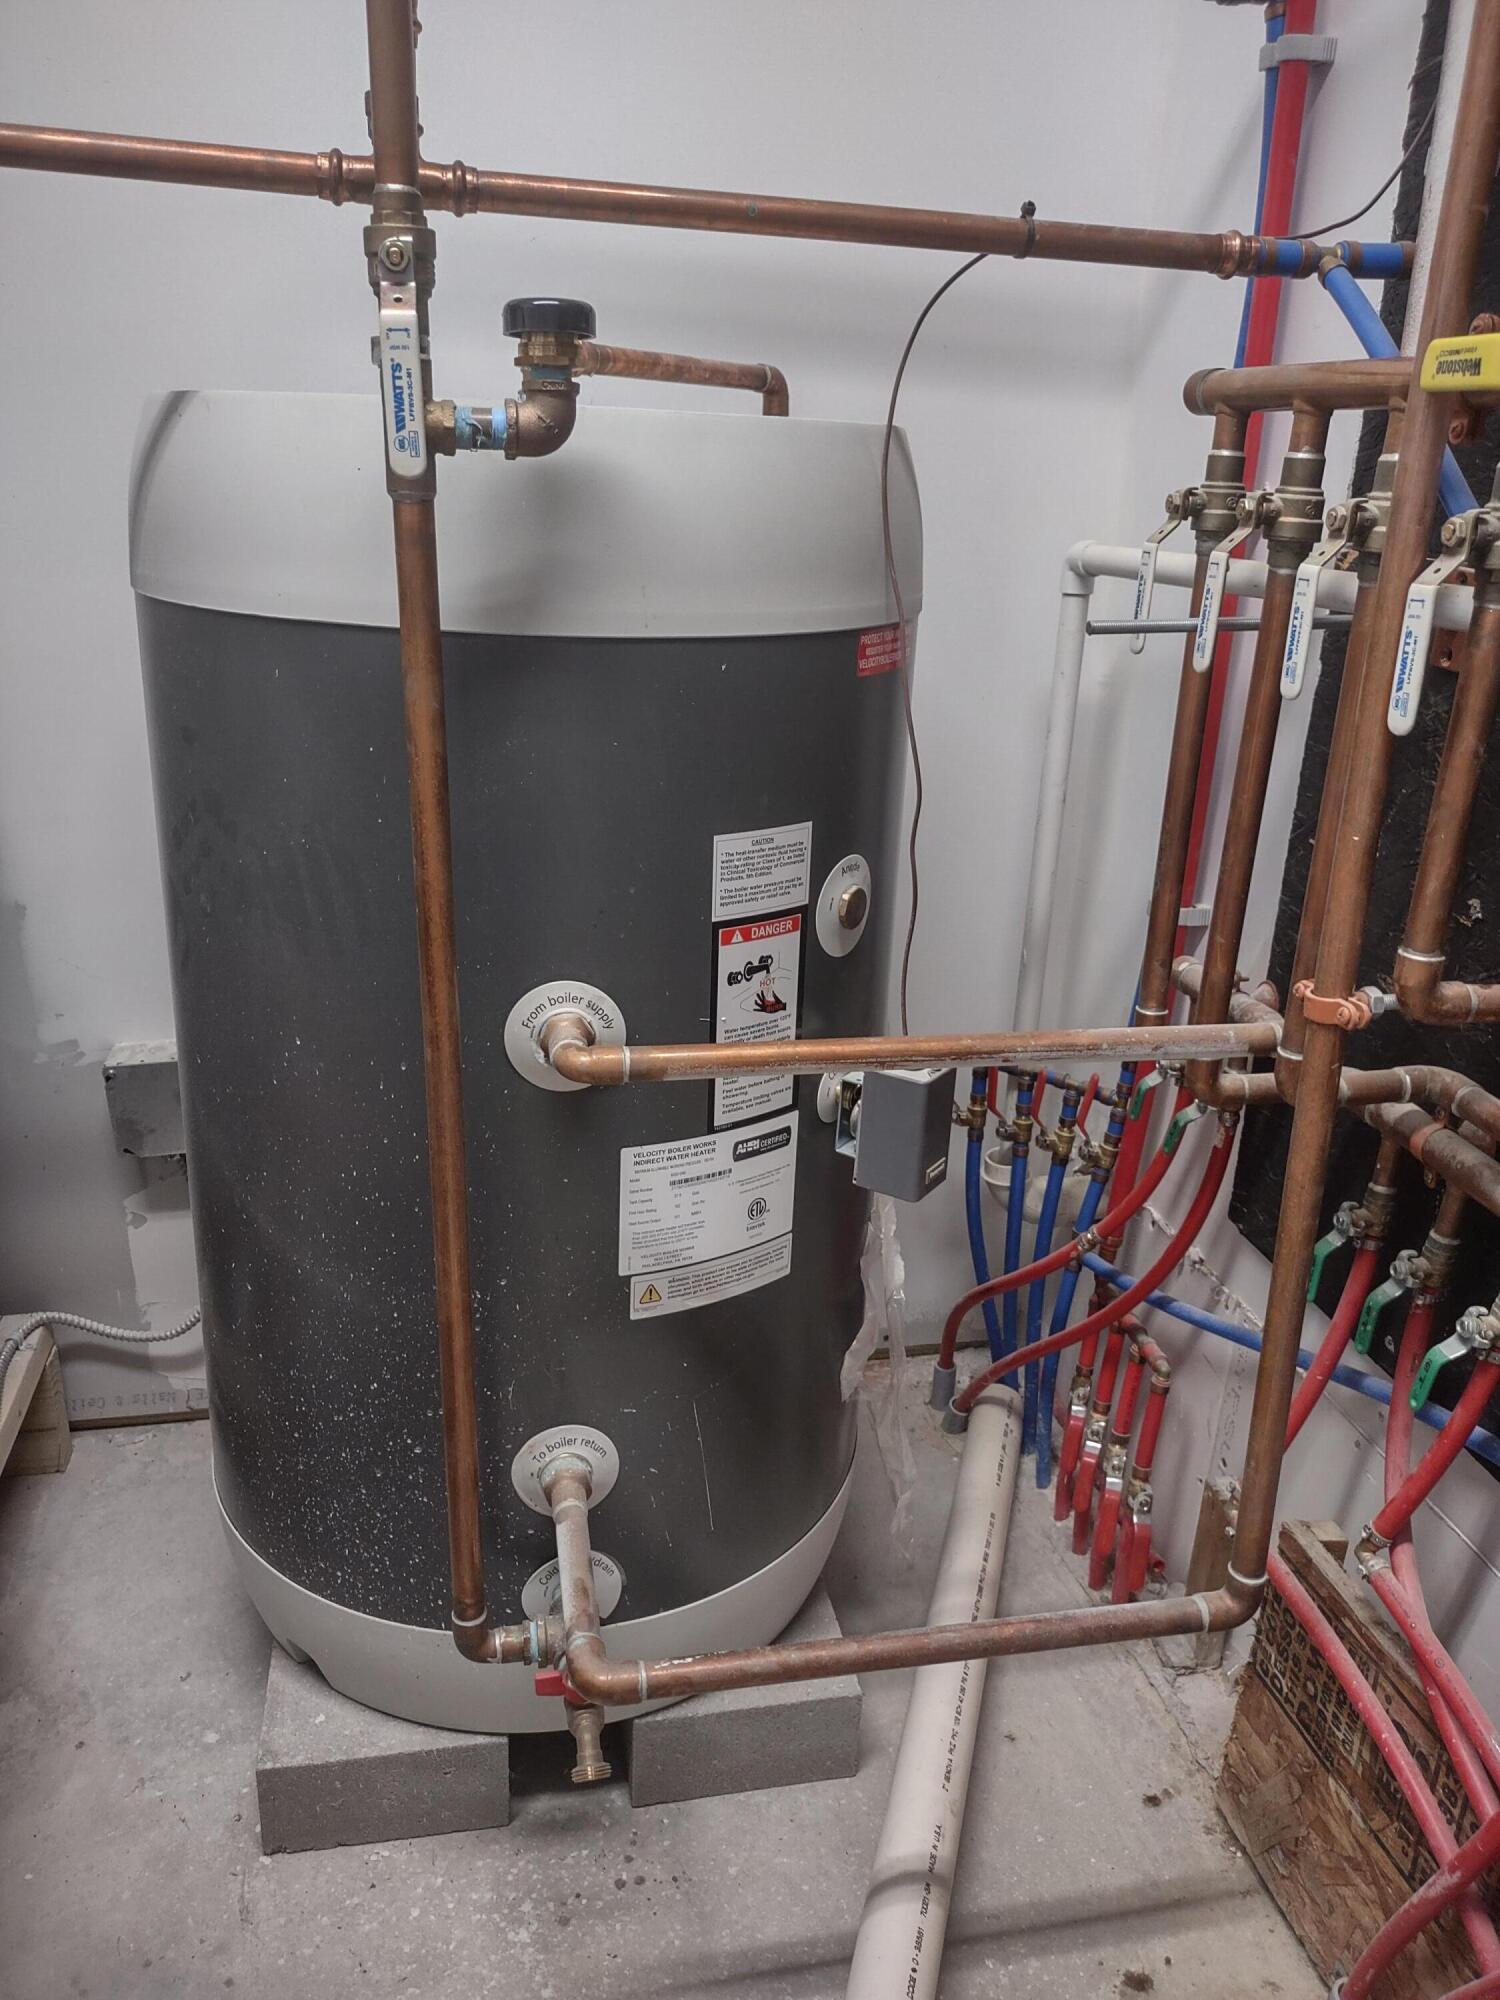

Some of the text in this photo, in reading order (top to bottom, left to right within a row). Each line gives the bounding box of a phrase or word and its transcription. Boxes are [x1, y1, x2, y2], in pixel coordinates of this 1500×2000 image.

[1436, 358, 1482, 376] Webstone
[392, 362, 406, 419] WATTS
[1288, 606, 1300, 659] WATTS
[1397, 629, 1412, 689] WATTS
[751, 920, 793, 938] DANGER
[760, 977, 776, 987] HOT
[522, 992, 614, 1029] From boiler supply
[633, 1140, 717, 1159] VELOCITY BOILER WORKS
[760, 1132, 788, 1148] CERTIFIED
[633, 1156, 664, 1167] INDIRECT
[666, 1152, 689, 1162] WATER
[691, 1148, 716, 1159] HEATER
[532, 1437, 607, 1464] To boiler return
[539, 1556, 614, 1586] Cold drain
[928, 1852, 937, 1874] MADE
